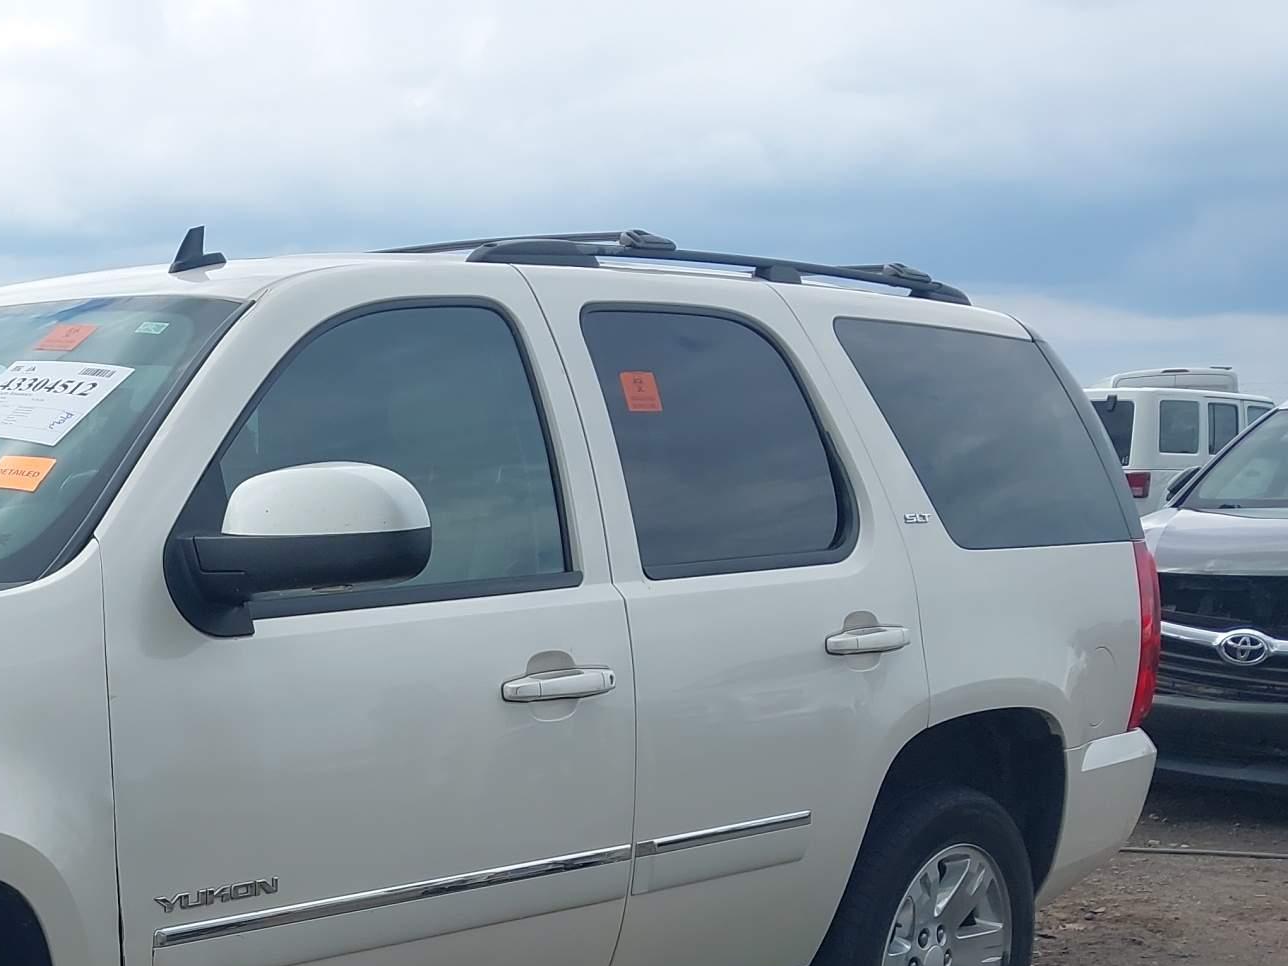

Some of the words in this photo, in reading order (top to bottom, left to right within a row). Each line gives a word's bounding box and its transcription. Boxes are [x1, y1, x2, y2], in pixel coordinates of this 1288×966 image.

[0, 376, 99, 396] 43304512
[904, 512, 931, 524] SLT
[153, 876, 280, 914] YUKON
